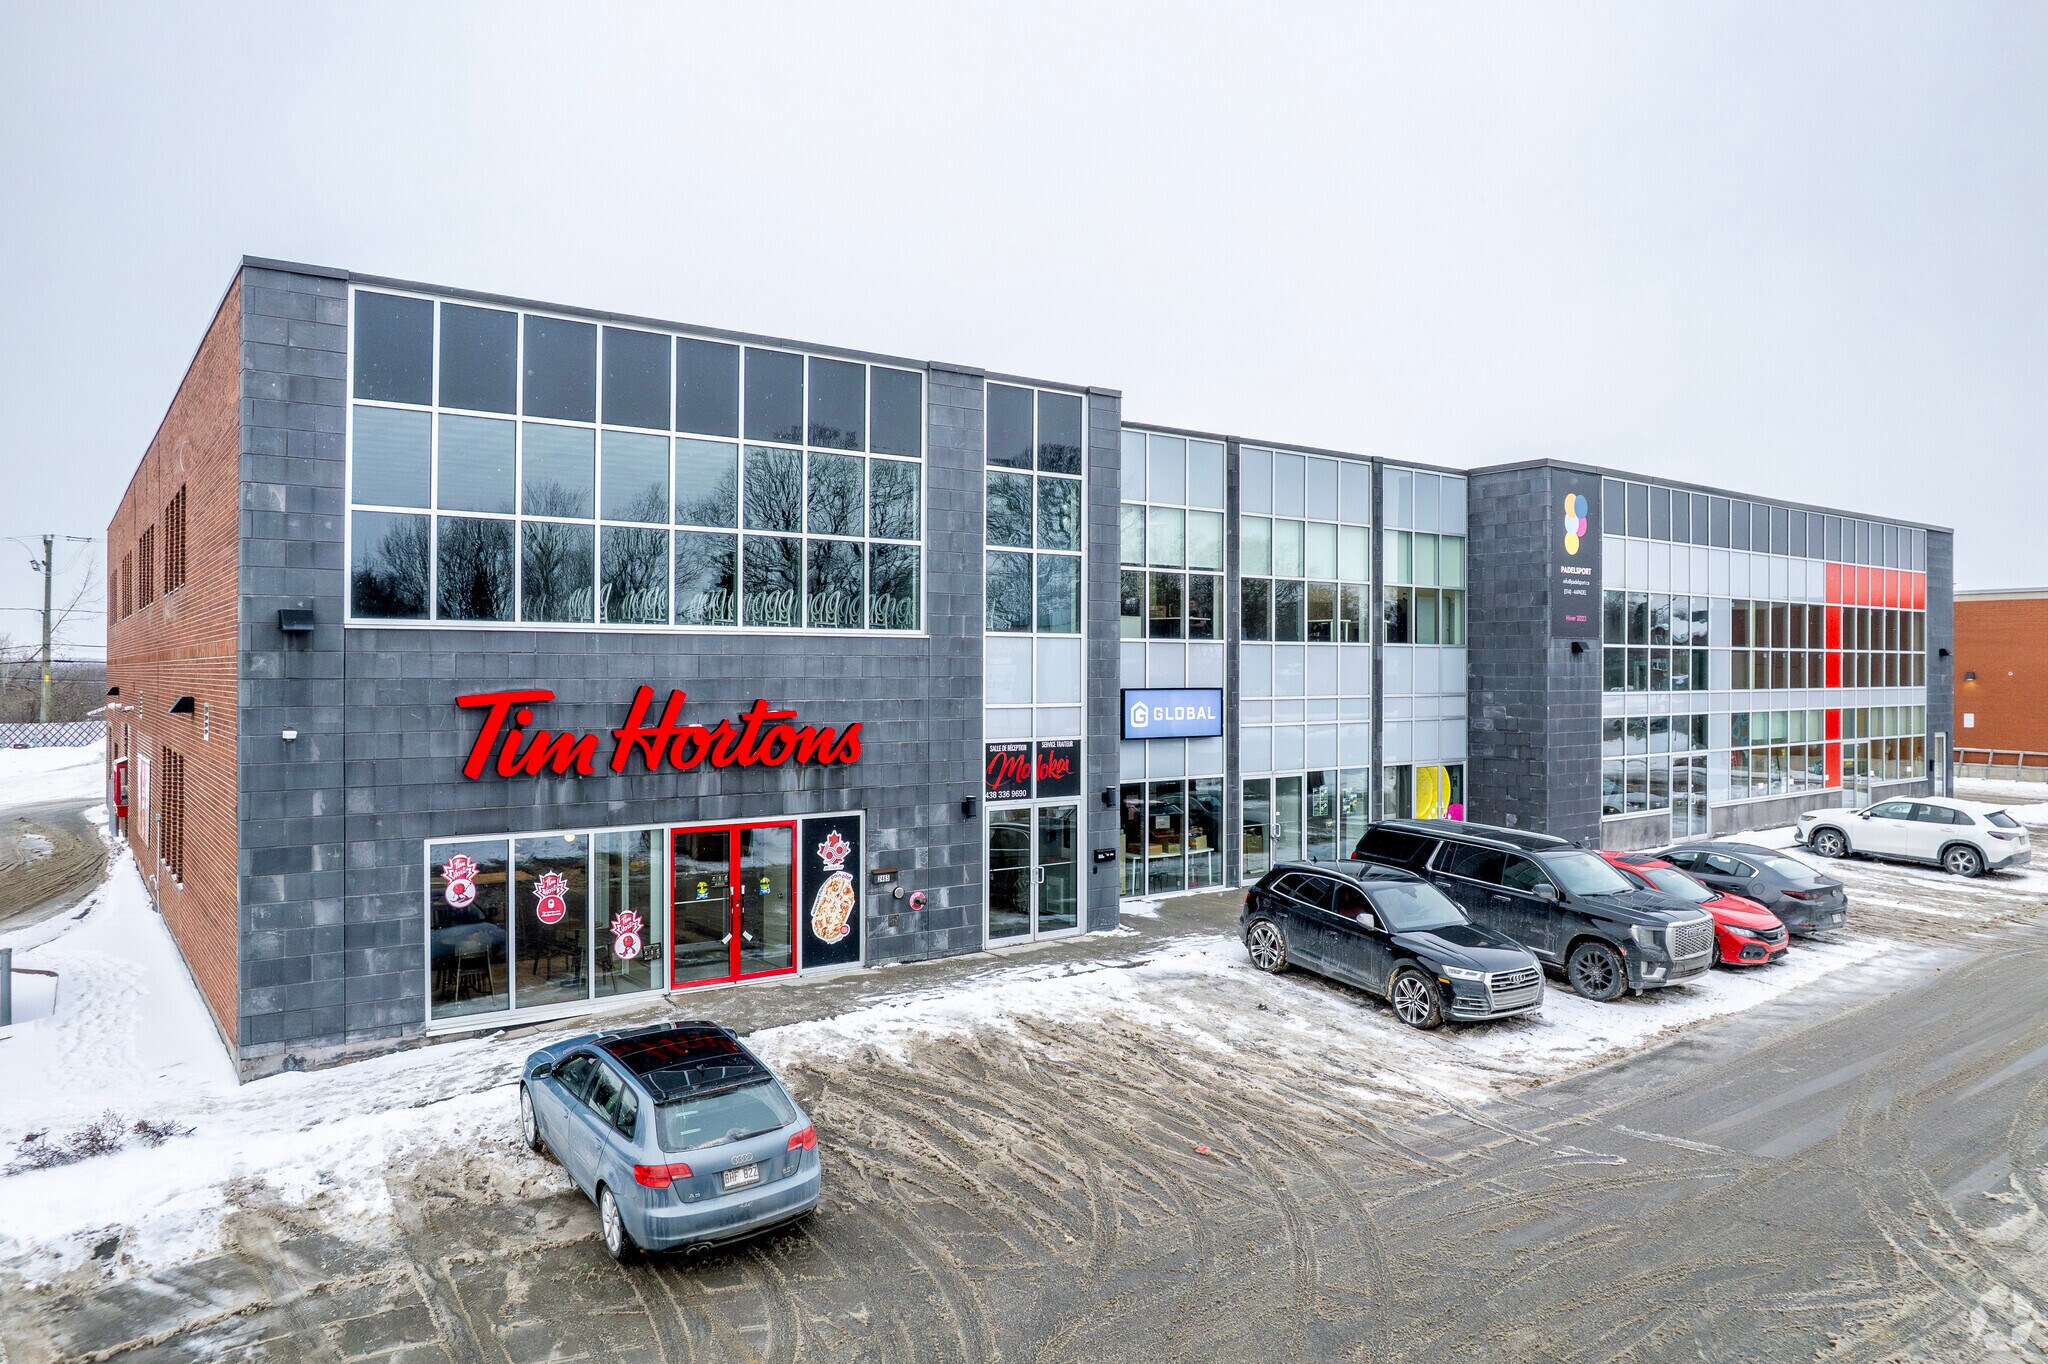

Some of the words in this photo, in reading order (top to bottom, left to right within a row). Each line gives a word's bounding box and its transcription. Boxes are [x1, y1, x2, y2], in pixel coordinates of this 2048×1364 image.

[1561, 566, 1592, 575] PADELSPORT
[1153, 706, 1216, 721] GLOBAL
[455, 690, 599, 780] Tim
[610, 685, 862, 773] Hortons
[1007, 743, 1027, 752] RÉCEPTION
[1057, 740, 1074, 748] TRAITEUR
[986, 750, 1075, 790] Molokai
[985, 791, 997, 799] 438
[1011, 789, 1027, 798] 9690
